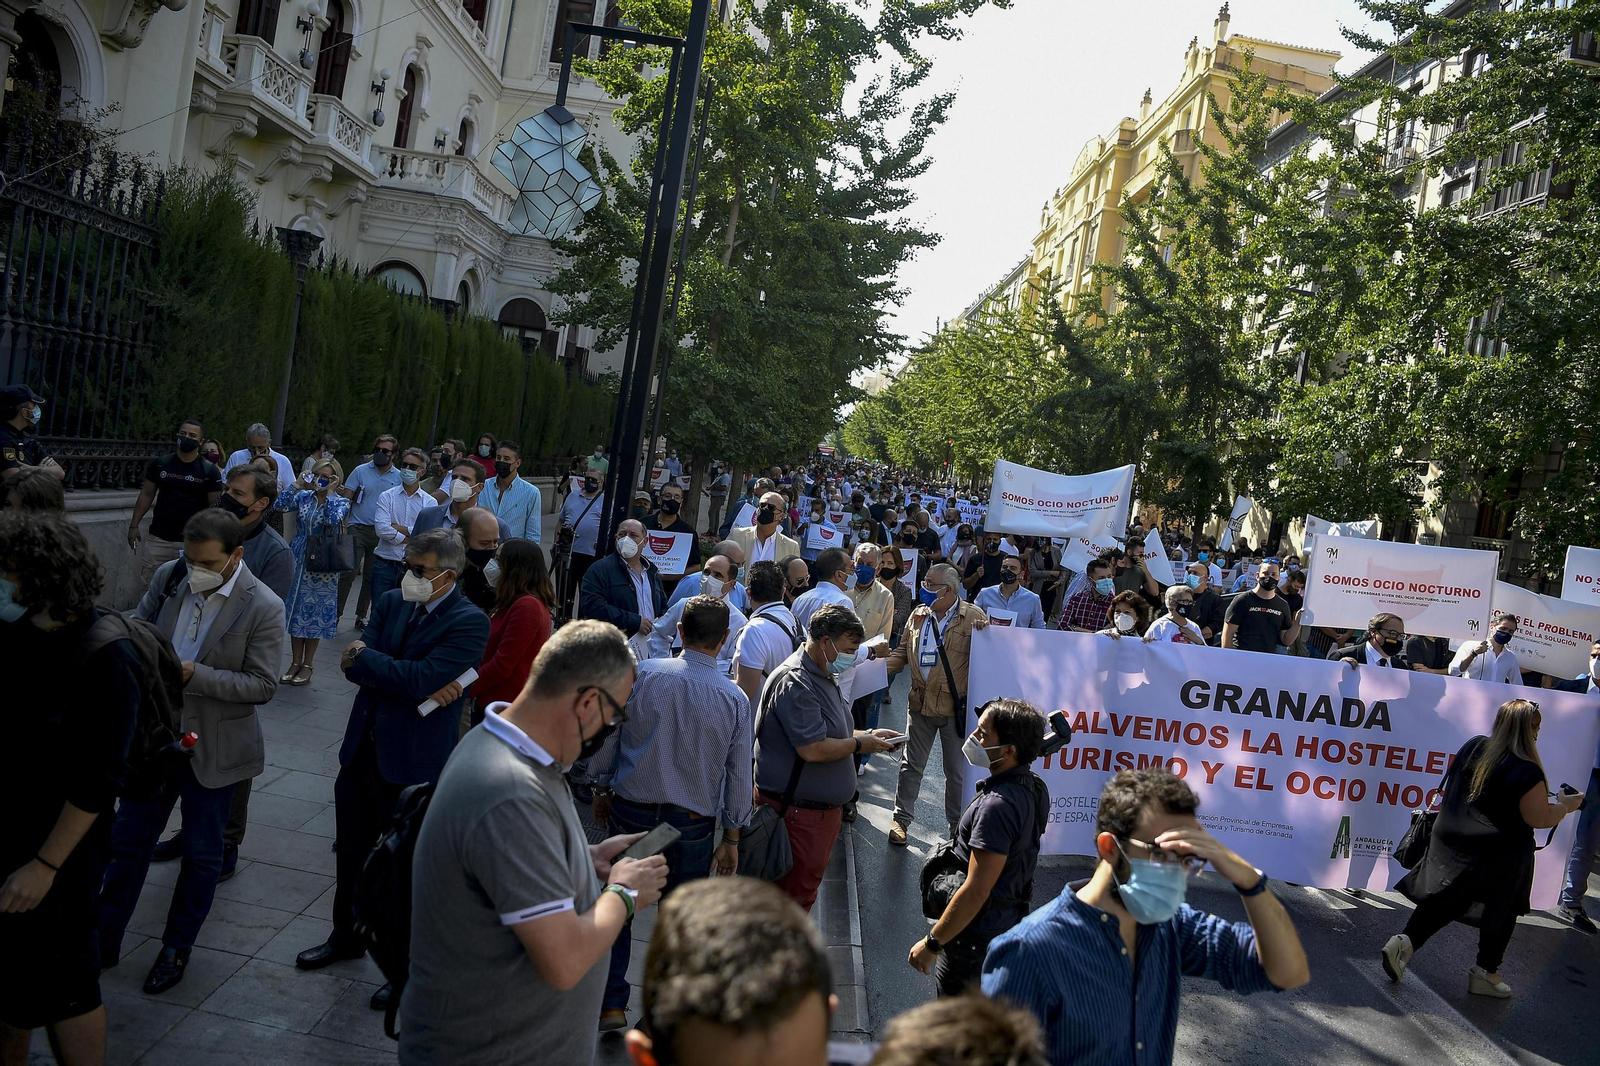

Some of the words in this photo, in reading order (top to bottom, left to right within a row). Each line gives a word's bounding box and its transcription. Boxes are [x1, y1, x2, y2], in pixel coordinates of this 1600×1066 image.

[1001, 491, 1034, 506] SOMOS
[1037, 500, 1063, 508] OCIO
[1067, 495, 1119, 508] NOCTURNO
[1079, 537, 1090, 547] NO
[1323, 574, 1369, 588] SOMOS
[1373, 579, 1405, 591] OCIO
[1408, 582, 1482, 599] NOCTURNO
[1575, 574, 1593, 584] NO
[1265, 608, 1282, 616] JONES
[1523, 617, 1535, 628] EL
[1537, 621, 1593, 643] PROBLEMA
[1525, 629, 1533, 637] DE
[1544, 634, 1577, 647] SOLUCIÓN
[1179, 679, 1392, 733] GRANADA
[1241, 729, 1284, 757] LA
[1294, 735, 1457, 775] HOSTELE
[1201, 760, 1225, 784] Y
[1233, 766, 1274, 791] EL
[1286, 771, 1366, 802] OCIO
[1048, 811, 1062, 824] DE
[1220, 815, 1251, 825] Provincial
[1251, 819, 1260, 827] de
[1261, 820, 1294, 831] Empresas
[1230, 825, 1254, 834] Turismo
[1256, 827, 1264, 835] de
[1265, 829, 1293, 839] Granada
[1354, 837, 1394, 846] ANDALUCÍA
[1365, 845, 1393, 853] NOCHE
